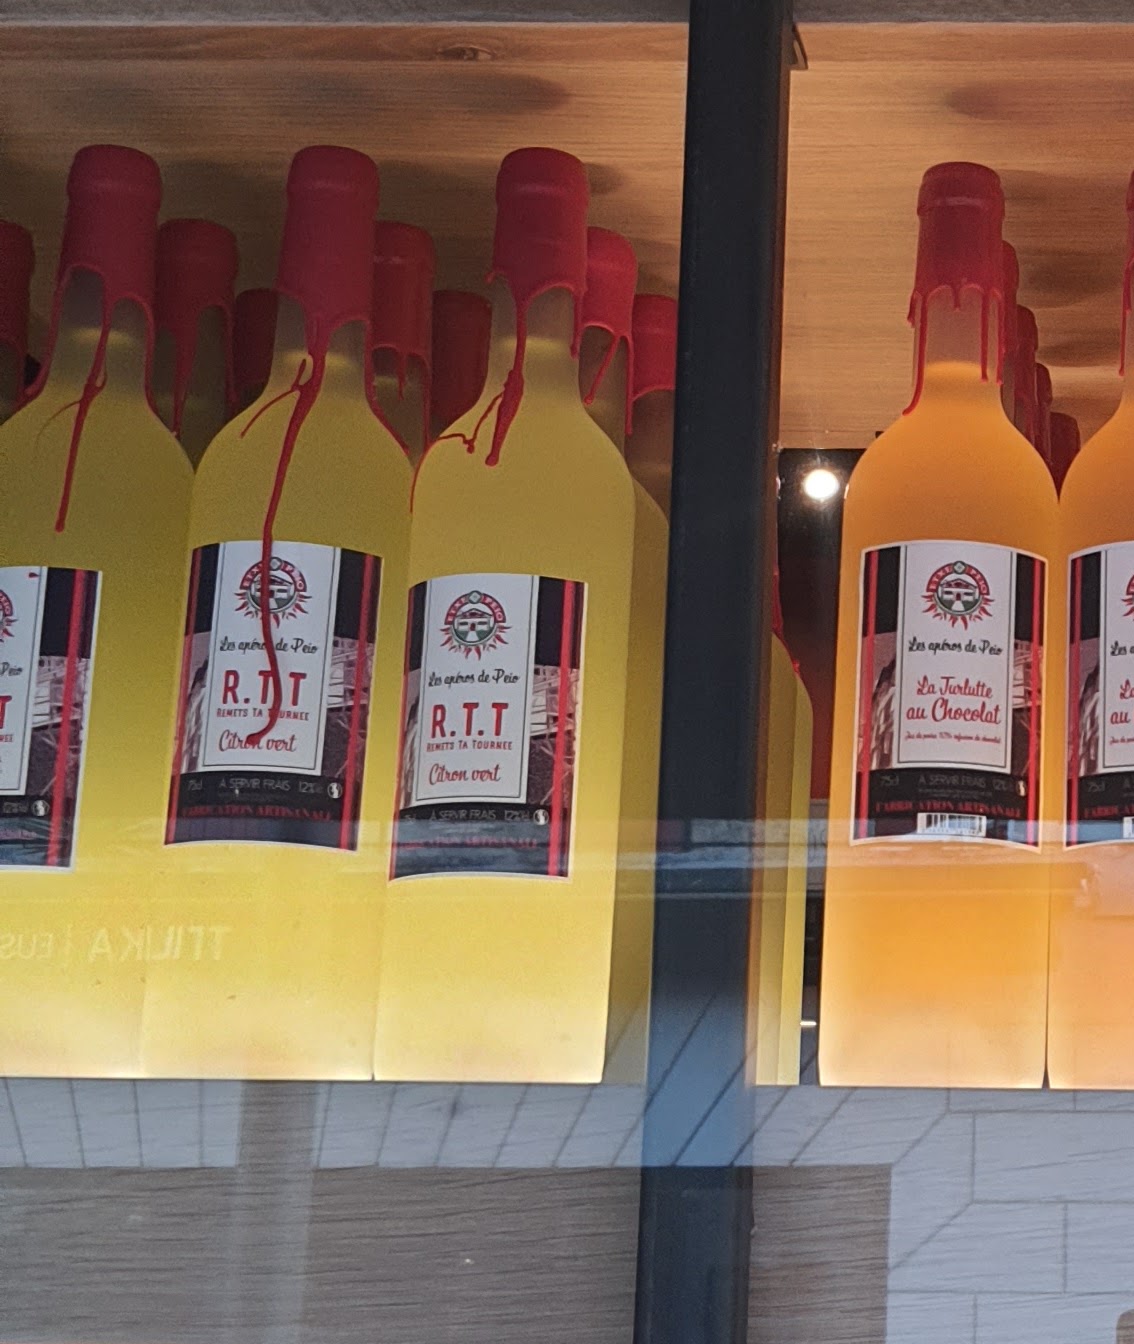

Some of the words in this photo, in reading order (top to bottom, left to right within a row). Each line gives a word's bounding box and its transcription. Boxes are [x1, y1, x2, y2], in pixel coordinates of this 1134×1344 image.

[219, 635, 236, 652] Les
[238, 638, 271, 655] apéro
[275, 637, 289, 652] de
[291, 637, 319, 654] Peio
[908, 636, 925, 653] Les
[928, 638, 962, 655] apéros
[964, 639, 977, 653] de
[978, 639, 1003, 656] Peio
[1110, 640, 1127, 657] Les
[222, 669, 307, 706] R.TT
[428, 671, 442, 687] Les
[444, 671, 475, 690] apéros
[477, 669, 490, 684] de
[491, 668, 521, 684] Peio
[916, 674, 936, 696] La
[939, 676, 994, 699] Turlutte
[216, 707, 248, 718] REMETS
[252, 708, 263, 718] TA
[267, 708, 310, 721] TURNEE
[430, 701, 509, 739] R.T.T
[906, 706, 927, 721] au
[931, 697, 1002, 725] Chocolat
[1109, 710, 1131, 725] au
[266, 733, 297, 752] vert
[426, 741, 455, 753] REMETS
[458, 739, 468, 750] TA
[472, 739, 513, 751] TOURNEE
[428, 763, 468, 786] Citron
[471, 763, 501, 782] vert
[469, 809, 496, 821] FRAIS
